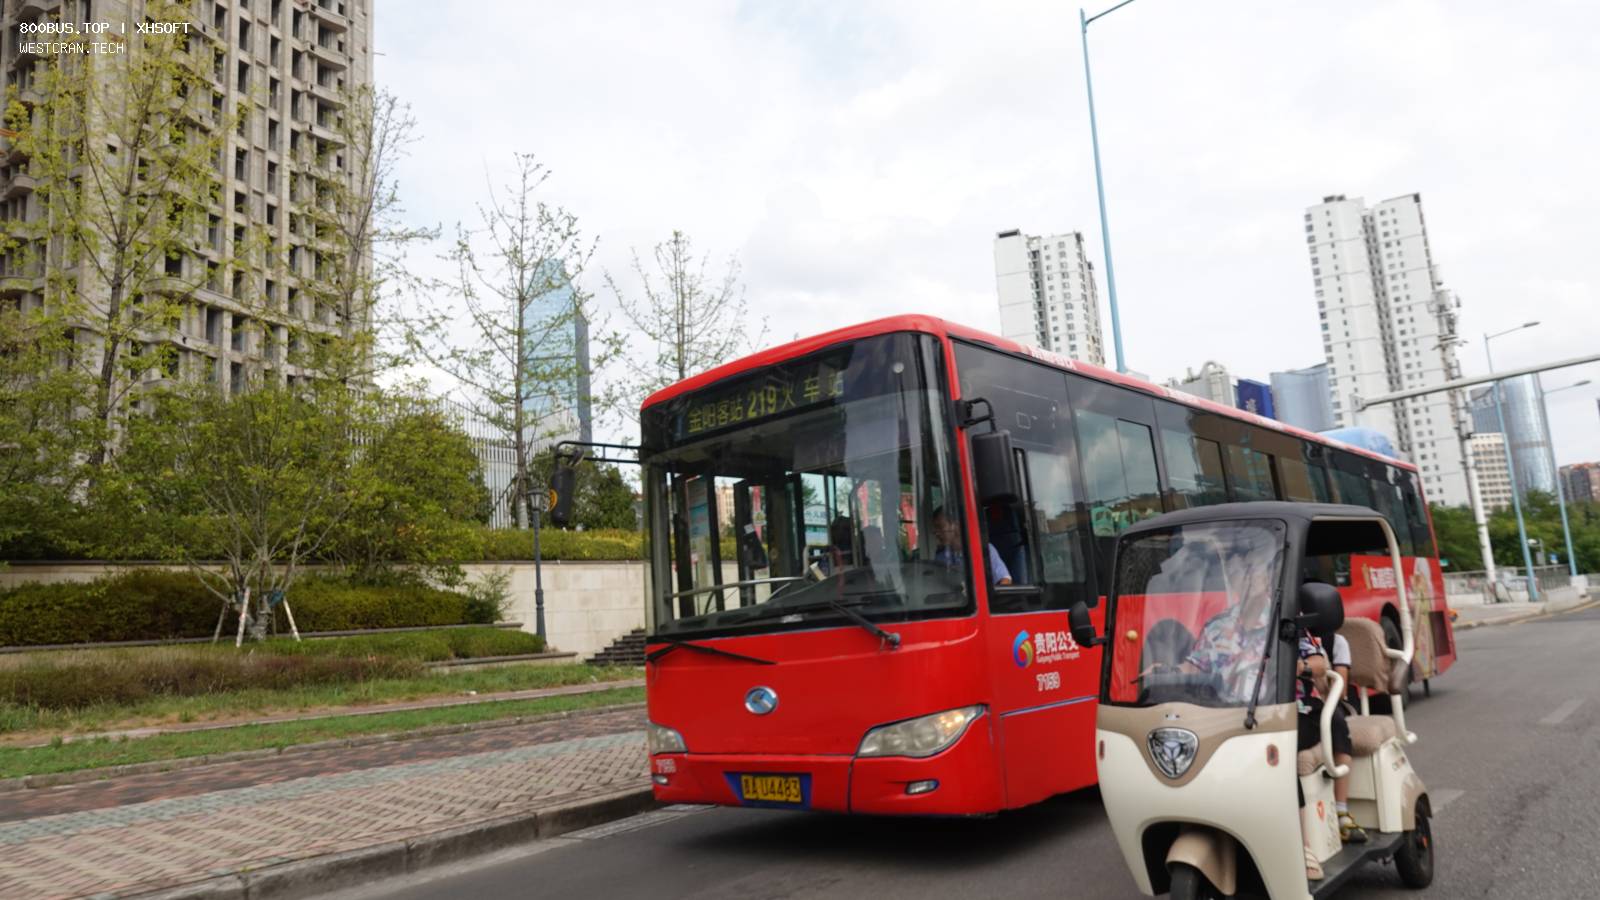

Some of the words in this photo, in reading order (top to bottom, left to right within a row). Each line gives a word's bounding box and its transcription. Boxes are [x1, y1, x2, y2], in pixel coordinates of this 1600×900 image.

[688, 396, 743, 433] 金阳客站
[746, 385, 777, 419] 219
[1035, 631, 1079, 655] 贵阳公交
